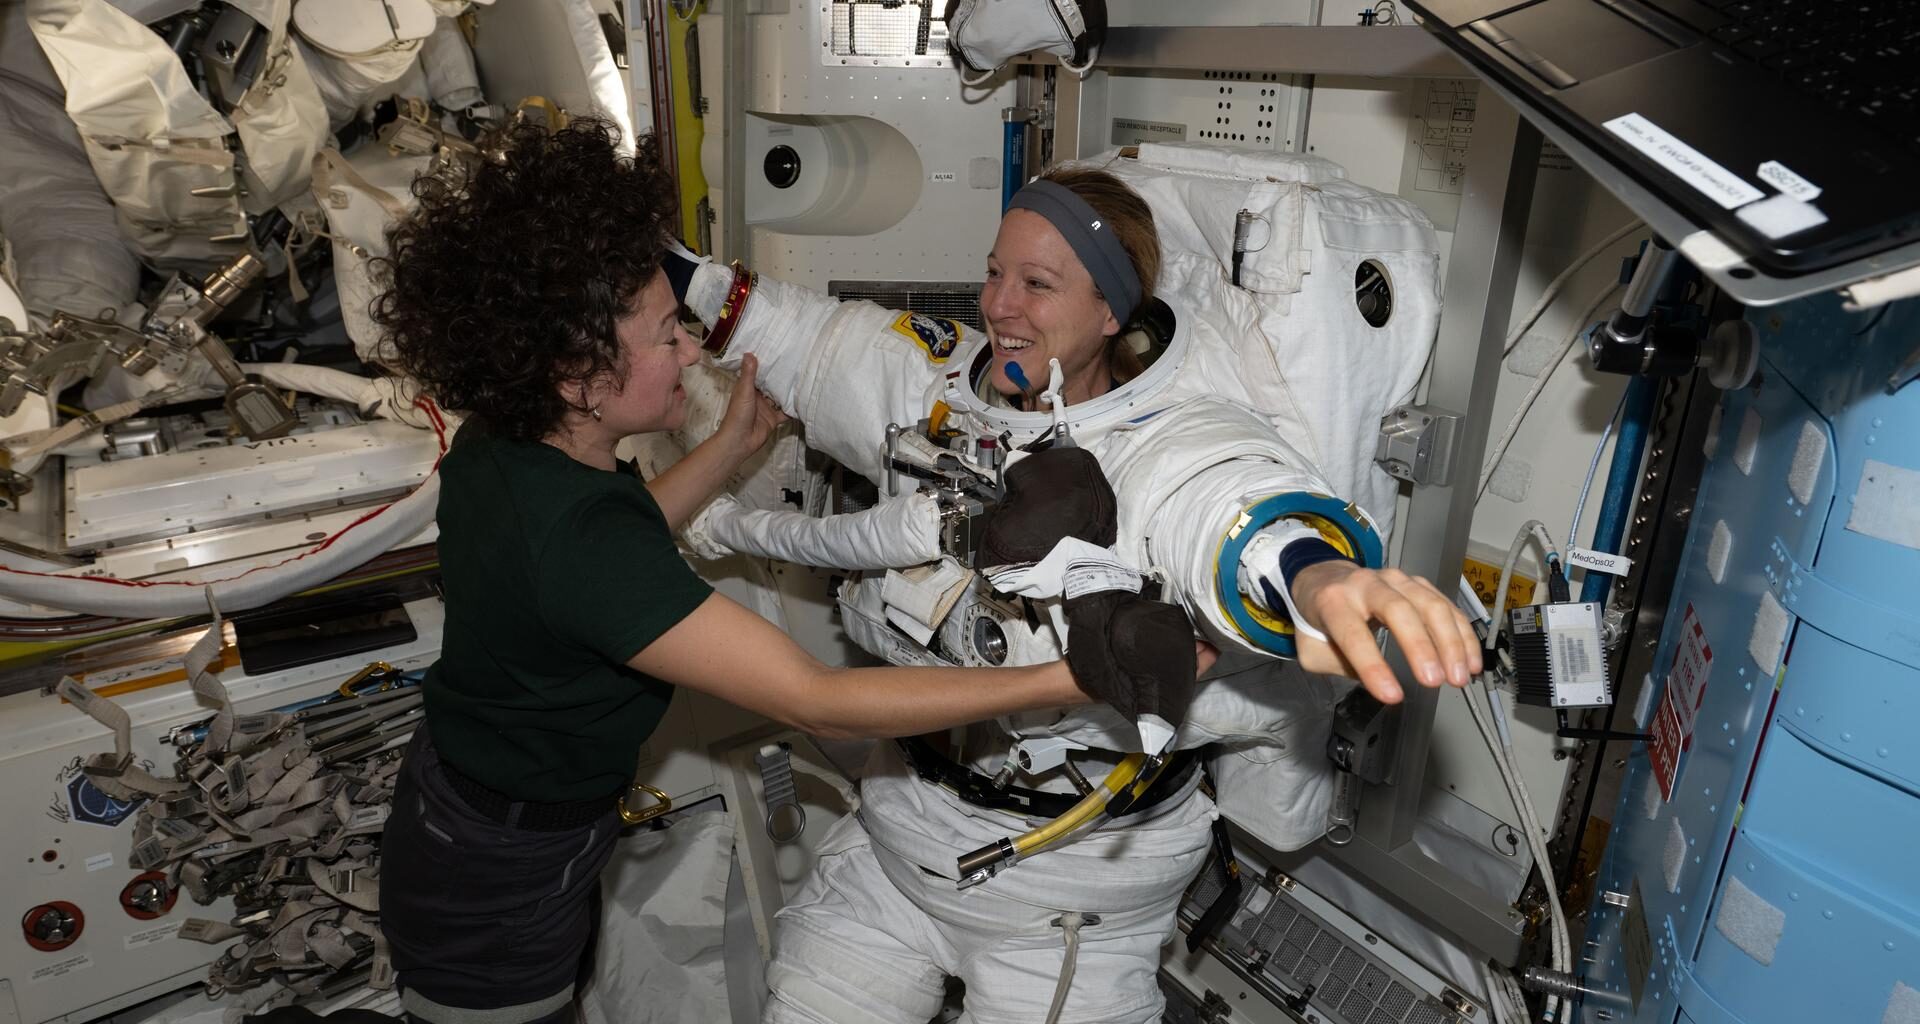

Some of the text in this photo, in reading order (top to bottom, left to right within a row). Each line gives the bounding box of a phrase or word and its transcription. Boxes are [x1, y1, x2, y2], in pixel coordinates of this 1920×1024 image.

[1150, 125, 1181, 134] RECEPTACLE
[1763, 165, 1809, 195] SSC15
[1572, 552, 1615, 567] MedOps02
[1682, 658, 1696, 691] FIRE
[1661, 694, 1677, 751] WATER
